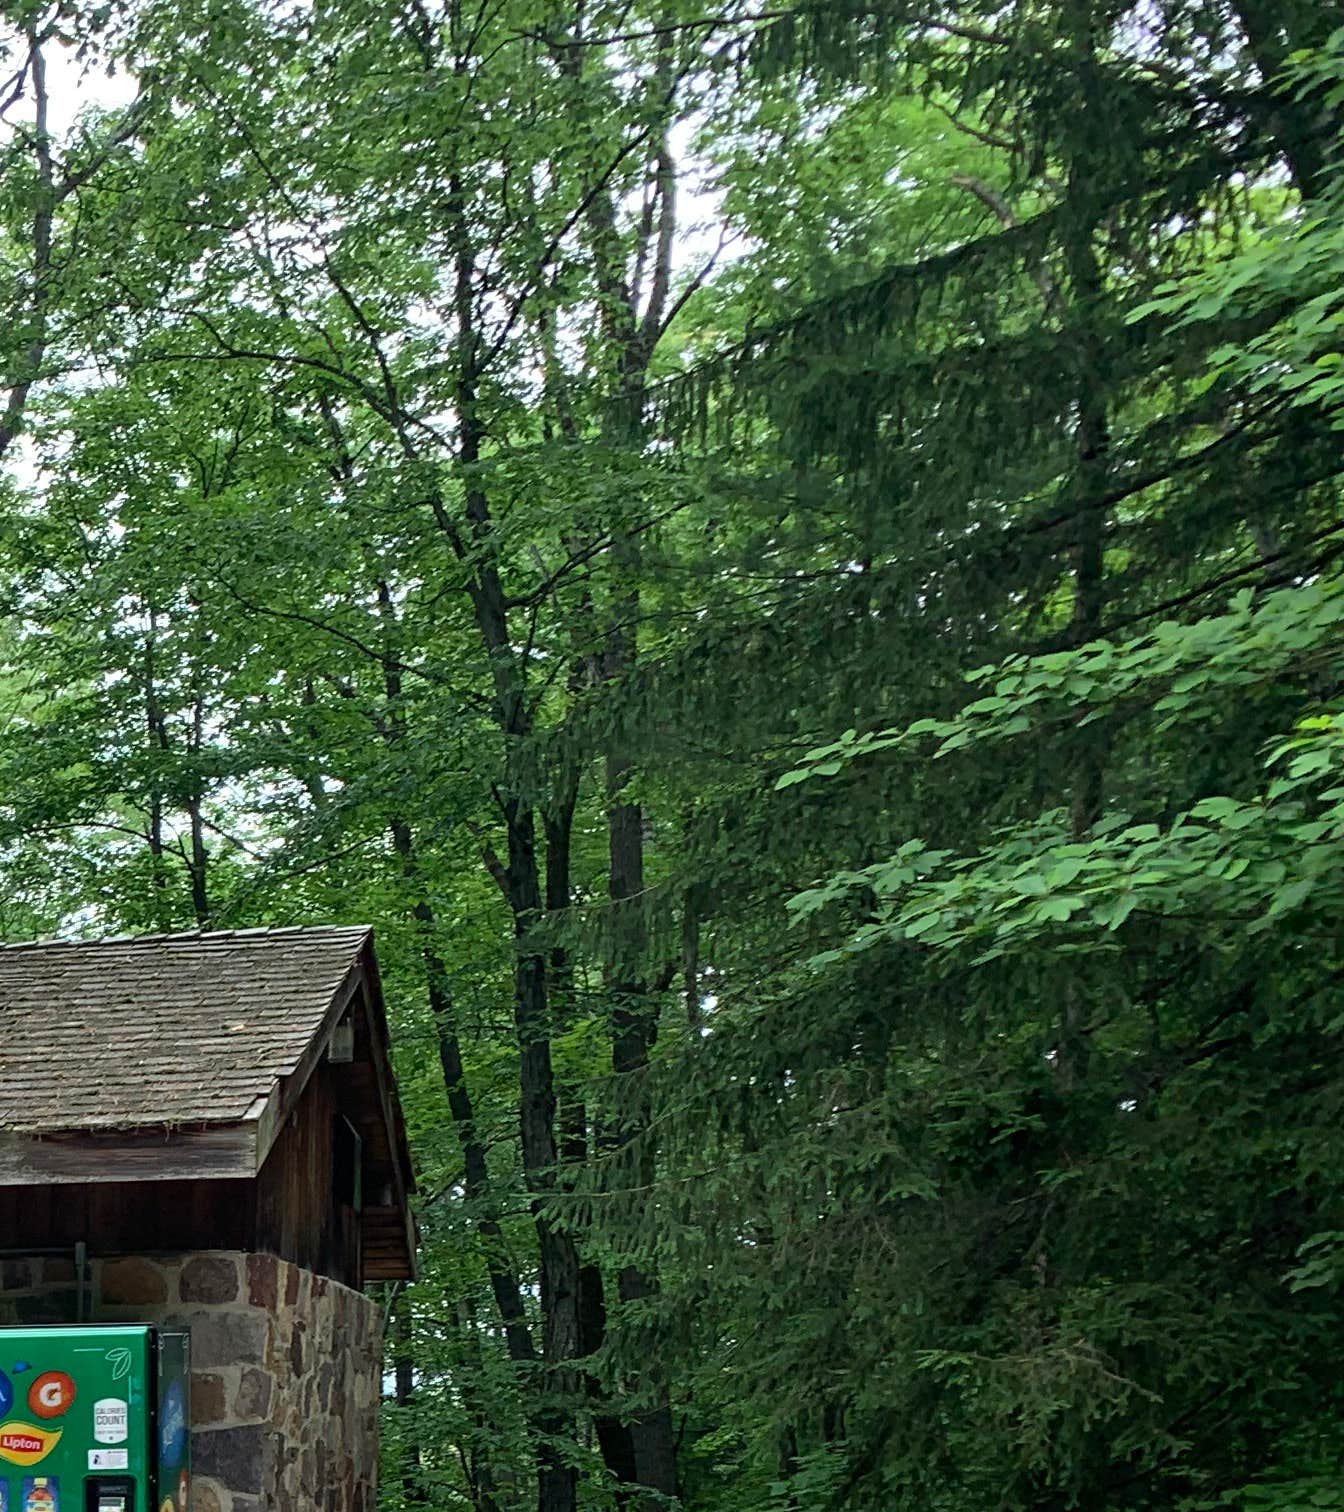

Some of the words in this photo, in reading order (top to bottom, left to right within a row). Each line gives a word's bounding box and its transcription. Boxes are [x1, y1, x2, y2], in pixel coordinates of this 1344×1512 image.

[39, 1382, 62, 1408] G
[96, 1415, 126, 1426] COUNT
[2, 1436, 41, 1450] Lipton
